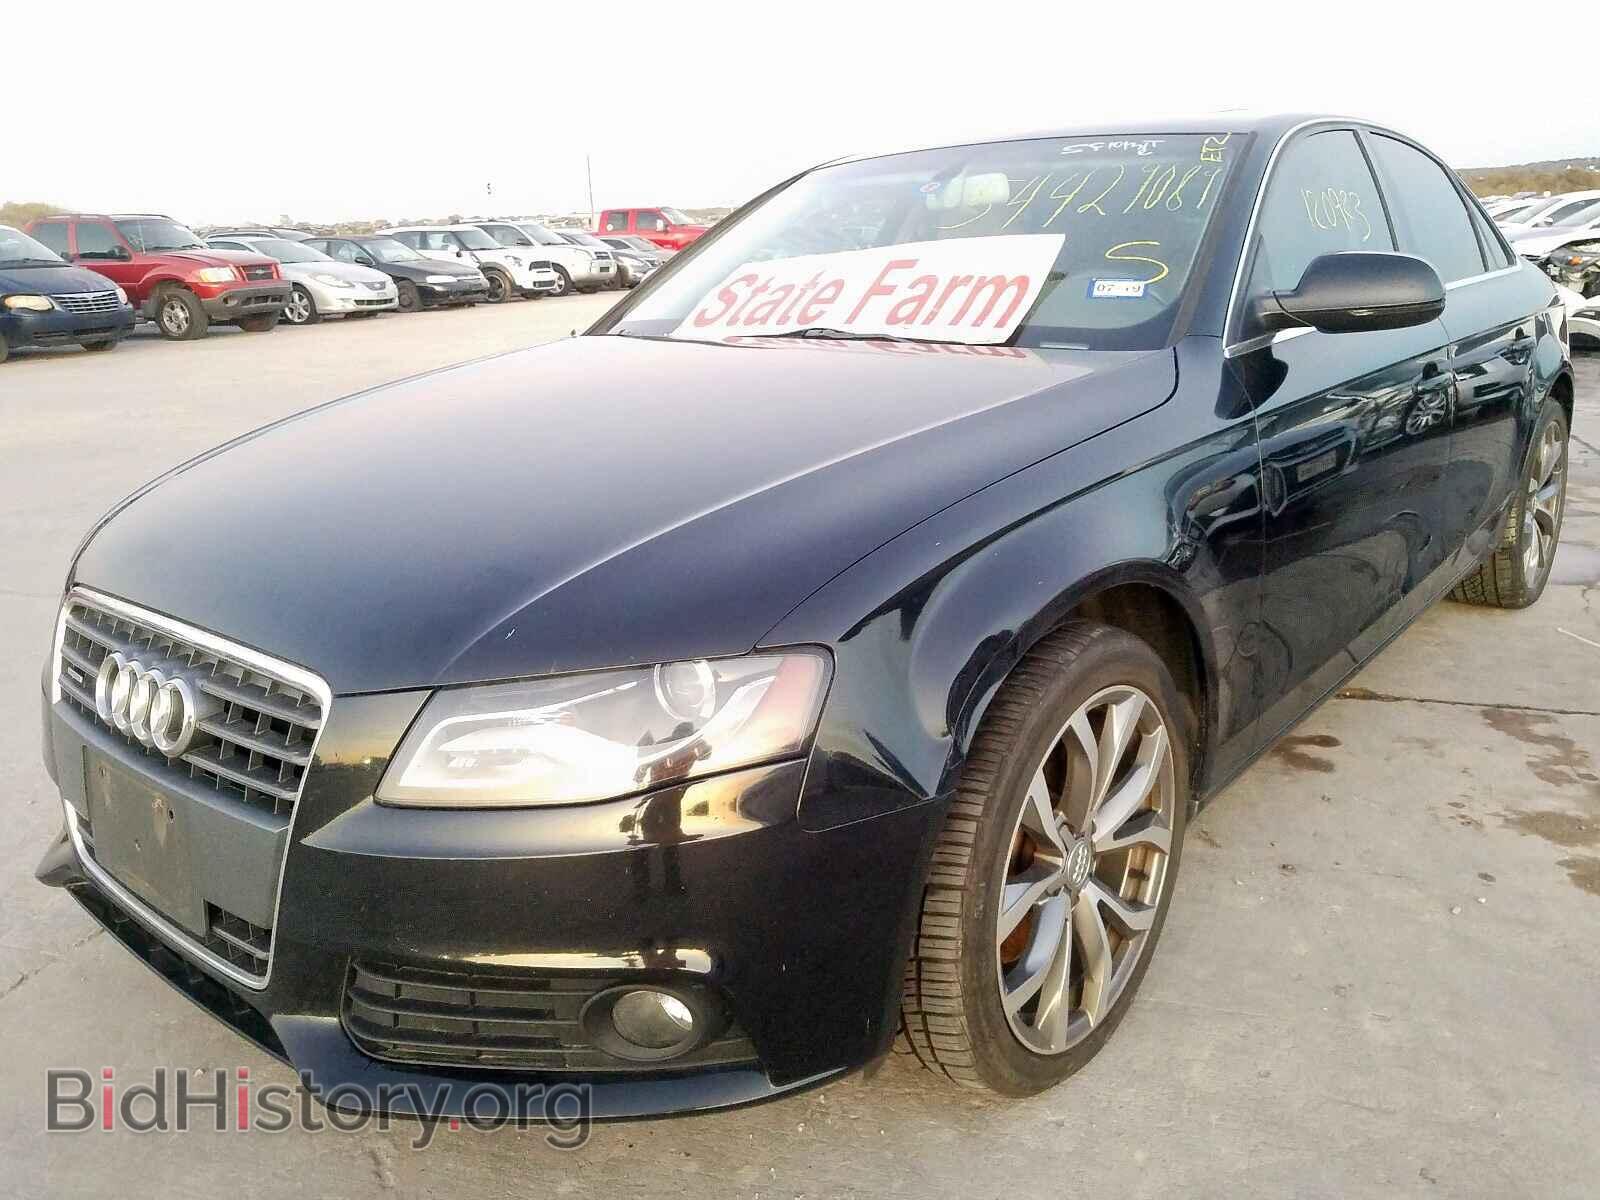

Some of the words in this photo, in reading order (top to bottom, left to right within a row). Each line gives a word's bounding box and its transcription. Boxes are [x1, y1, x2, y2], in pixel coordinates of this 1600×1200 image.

[1105, 240, 1169, 283] S
[693, 272, 846, 328] State
[847, 259, 1031, 329] Farm
